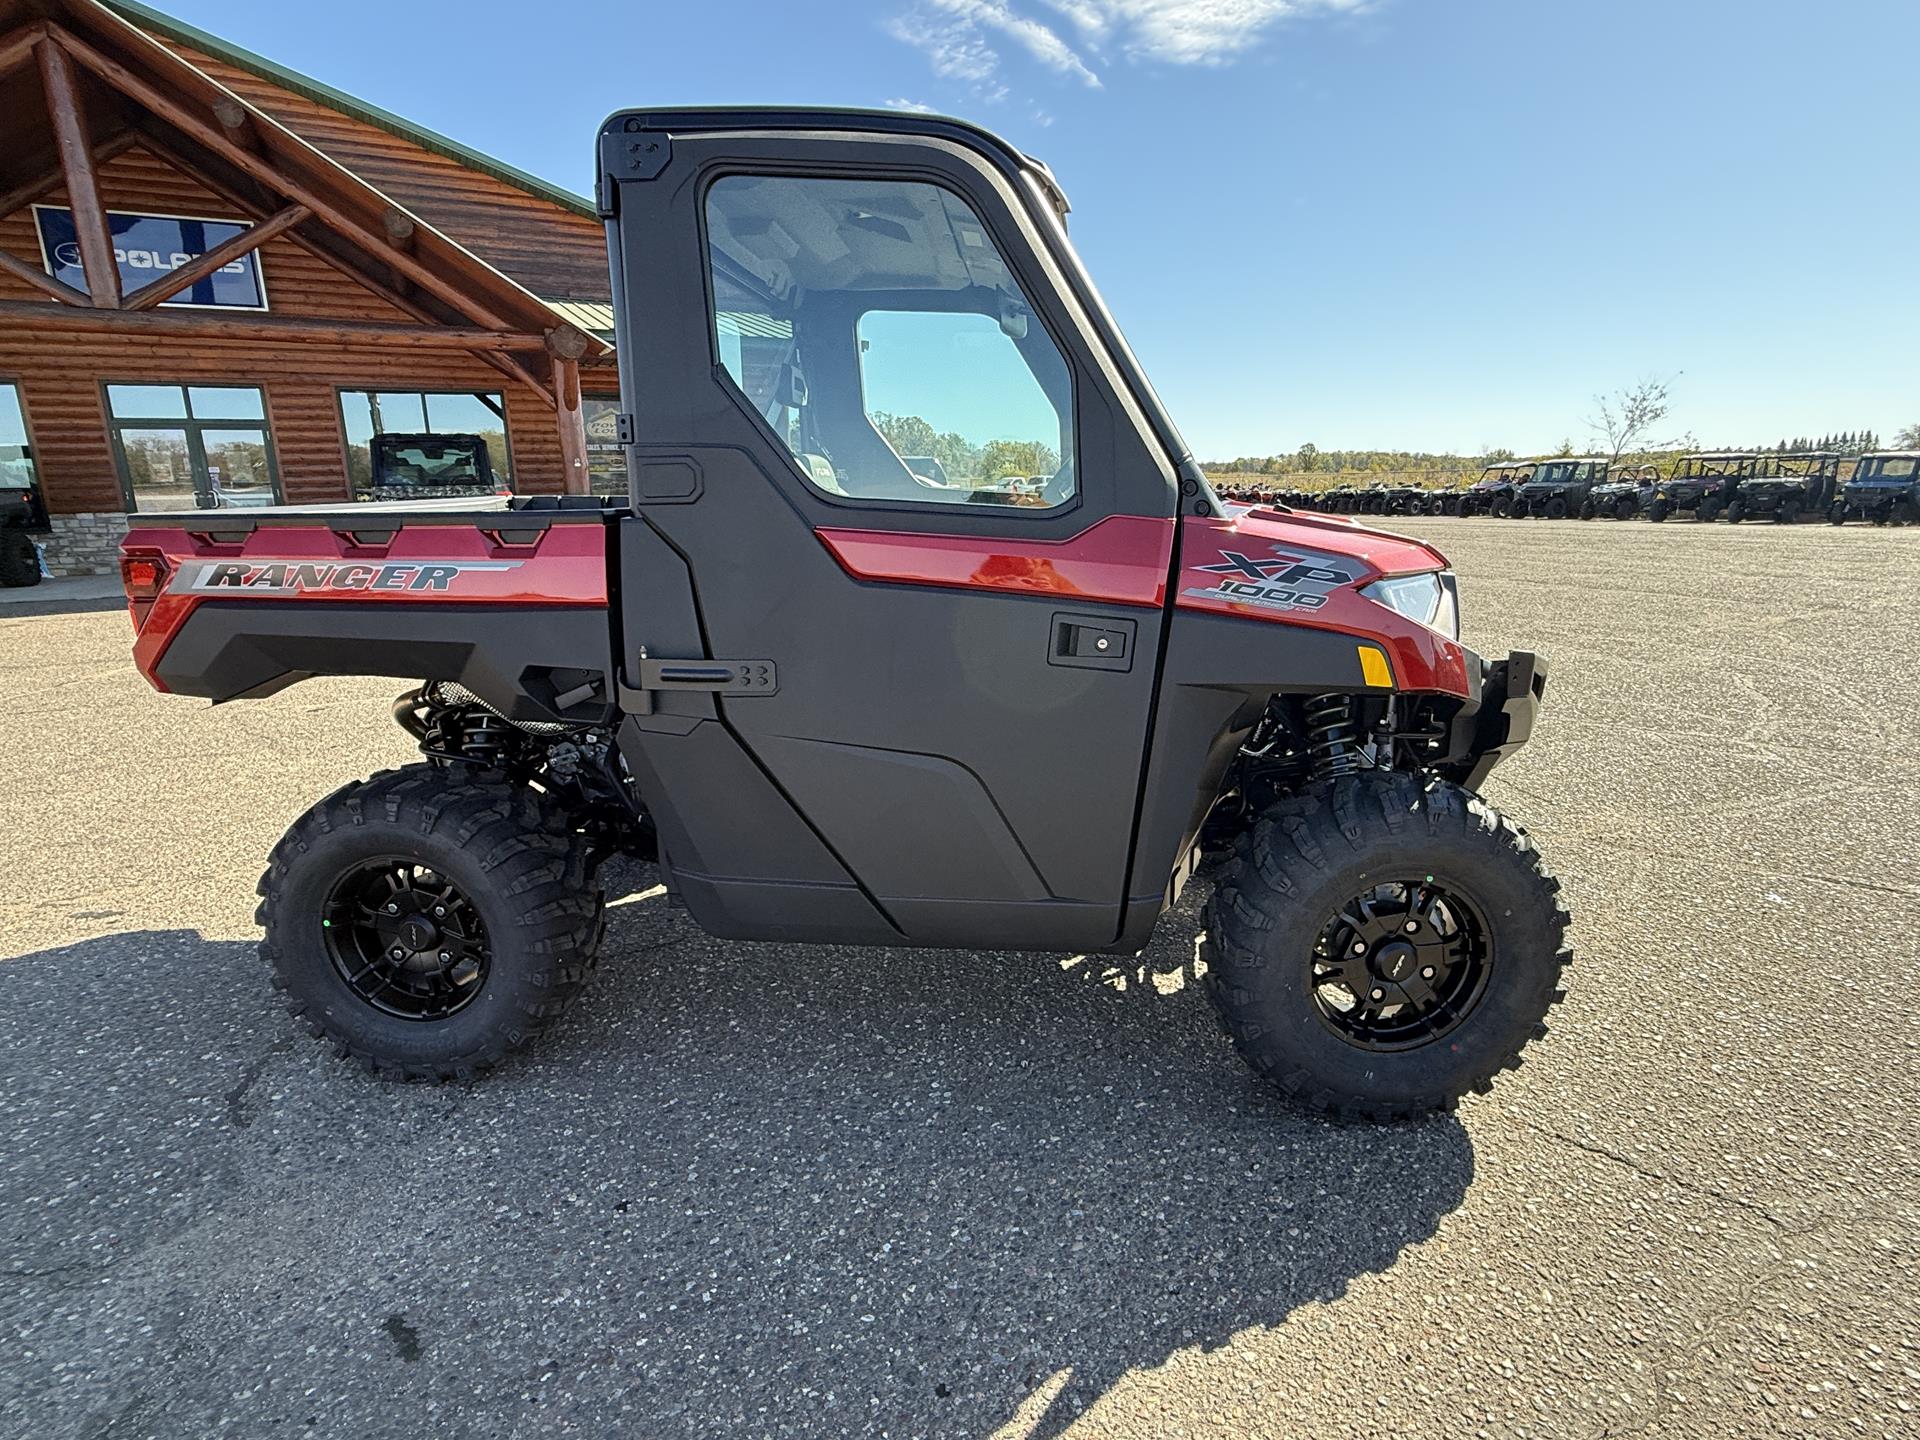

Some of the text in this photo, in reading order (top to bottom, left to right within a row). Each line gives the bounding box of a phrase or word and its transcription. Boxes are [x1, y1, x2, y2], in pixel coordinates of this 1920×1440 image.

[205, 563, 460, 592] RANGER
[1190, 549, 1354, 586] XP
[1217, 579, 1328, 609] 1000
